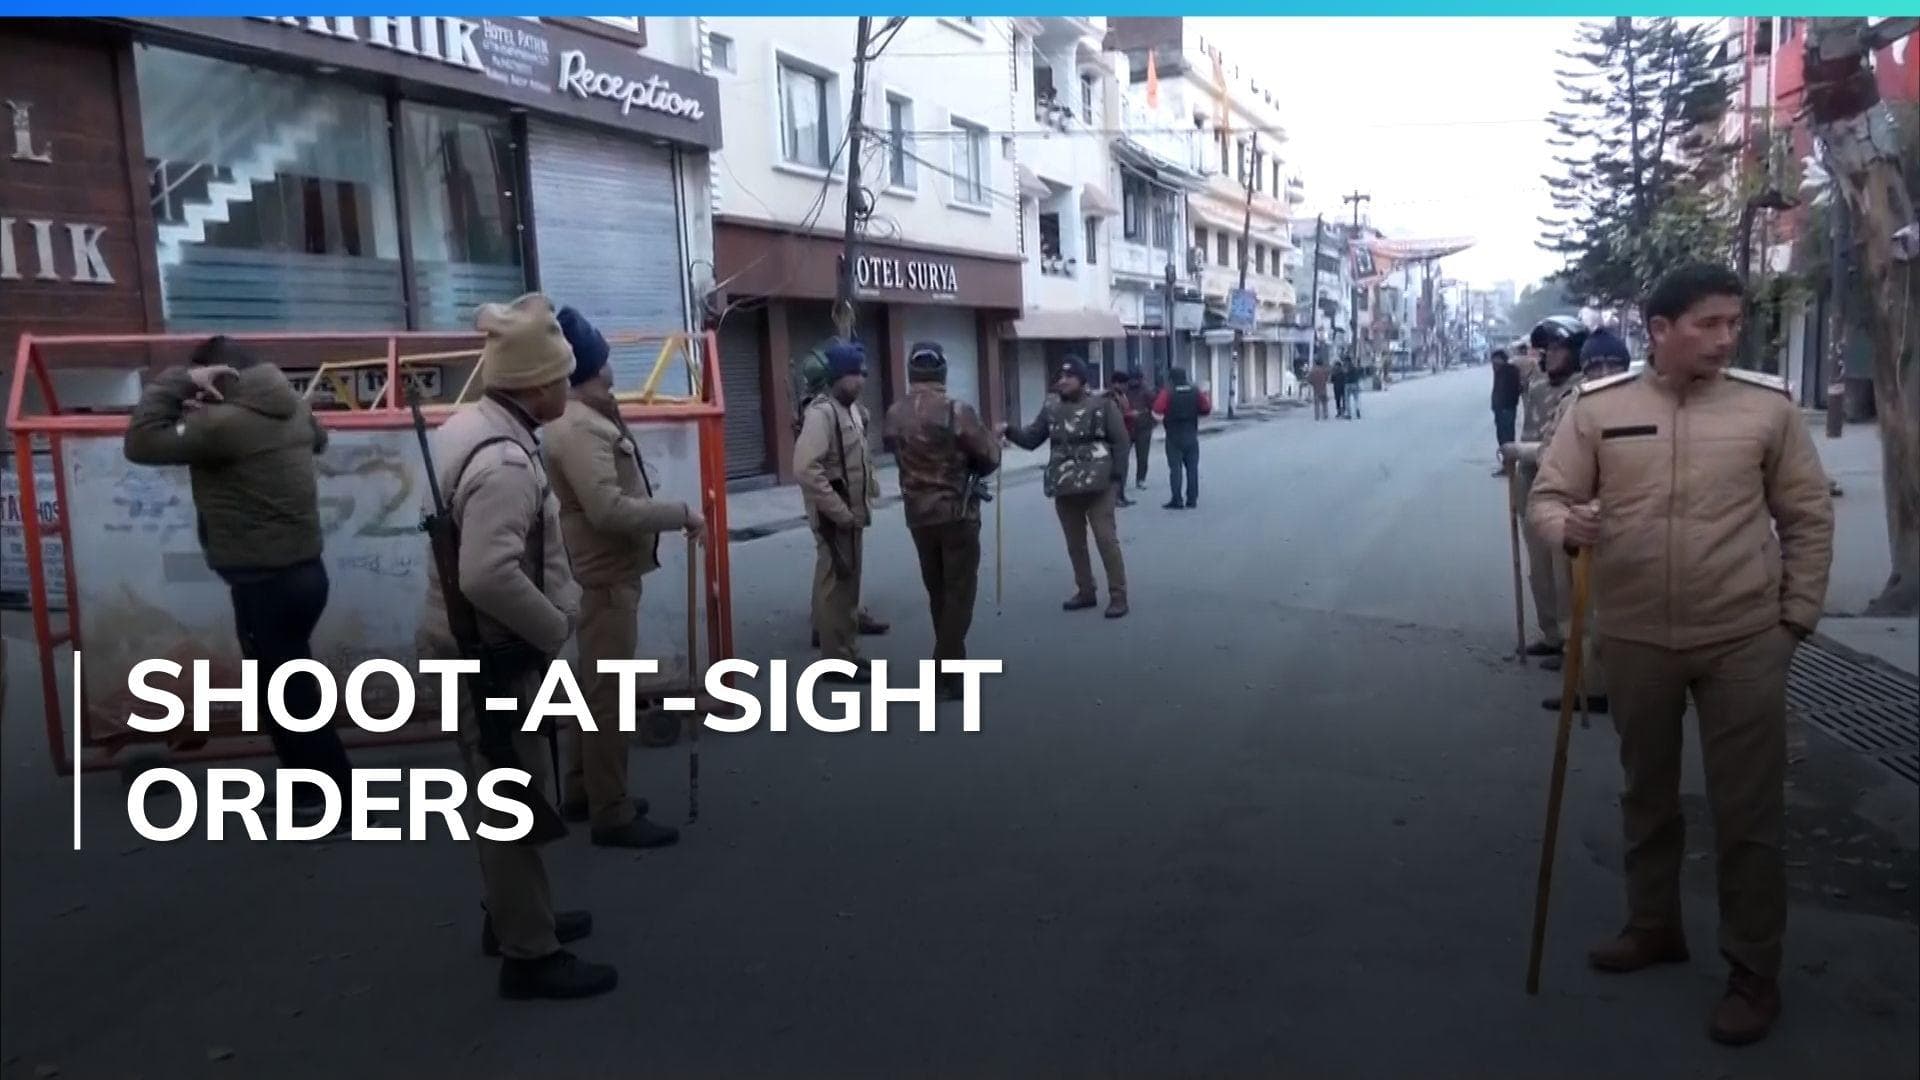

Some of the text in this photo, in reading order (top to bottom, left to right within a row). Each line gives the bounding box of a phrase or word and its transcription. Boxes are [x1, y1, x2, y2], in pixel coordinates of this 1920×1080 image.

[558, 49, 704, 121] Reception
[854, 255, 958, 292] OTEL SURYA
